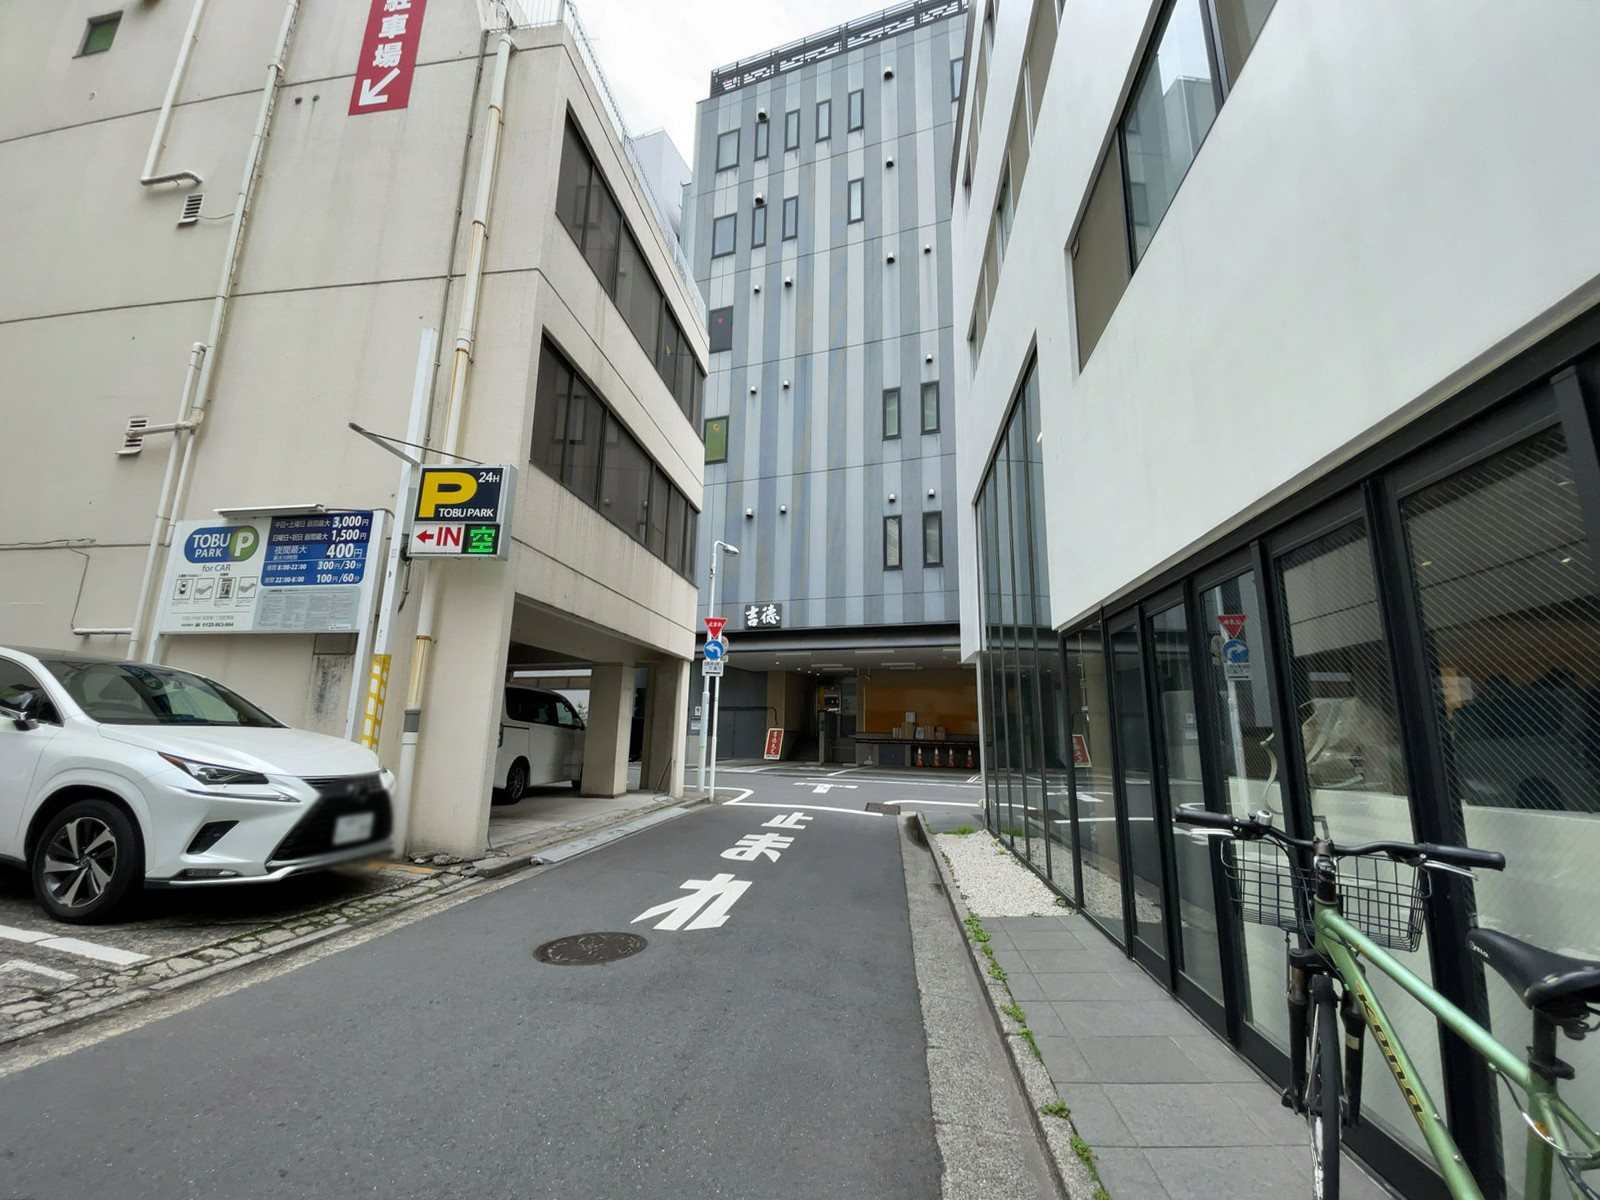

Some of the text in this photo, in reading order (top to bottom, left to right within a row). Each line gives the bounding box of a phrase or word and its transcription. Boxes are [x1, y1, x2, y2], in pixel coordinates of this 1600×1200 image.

[478, 471, 500, 483] 24H
[418, 471, 478, 518] P
[438, 508, 494, 518] TOBU PARK
[332, 515, 369, 529] 3,000円
[192, 533, 231, 548] TOBU
[331, 529, 367, 542] 1,500円
[436, 526, 462, 547] IN
[467, 526, 496, 553] 空
[233, 532, 255, 557] P
[274, 543, 363, 559] 夜間最大 400円
[194, 548, 223, 558] PARK
[201, 564, 231, 572] for CAR
[630, 811, 813, 931] 止まれ
